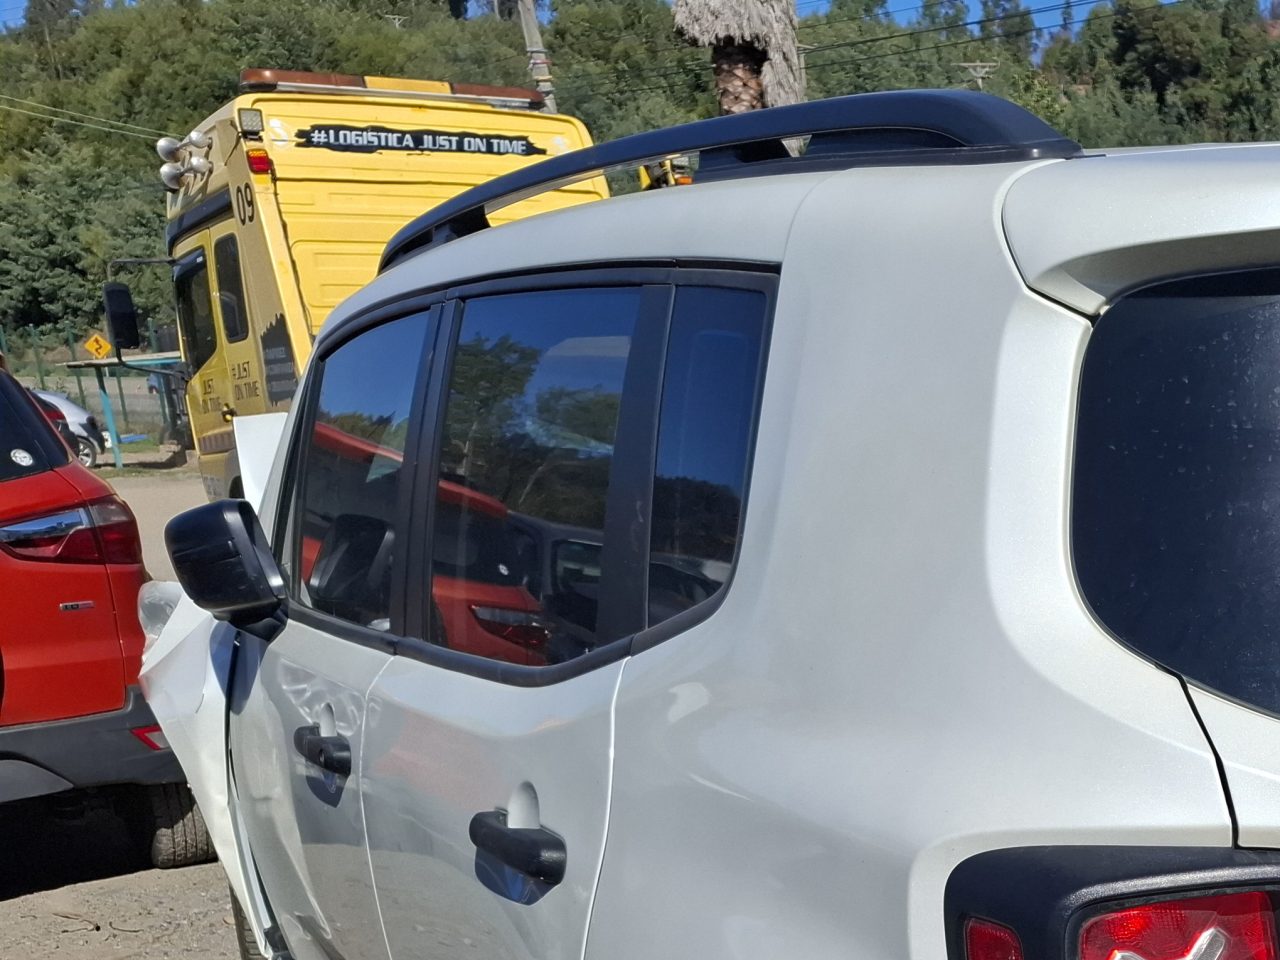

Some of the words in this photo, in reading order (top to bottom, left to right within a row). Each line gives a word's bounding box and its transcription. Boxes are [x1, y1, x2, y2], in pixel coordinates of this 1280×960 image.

[419, 134, 459, 151] JUST
[463, 136, 487, 152] ON
[490, 138, 527, 154] TIME
[235, 182, 255, 226] 09
